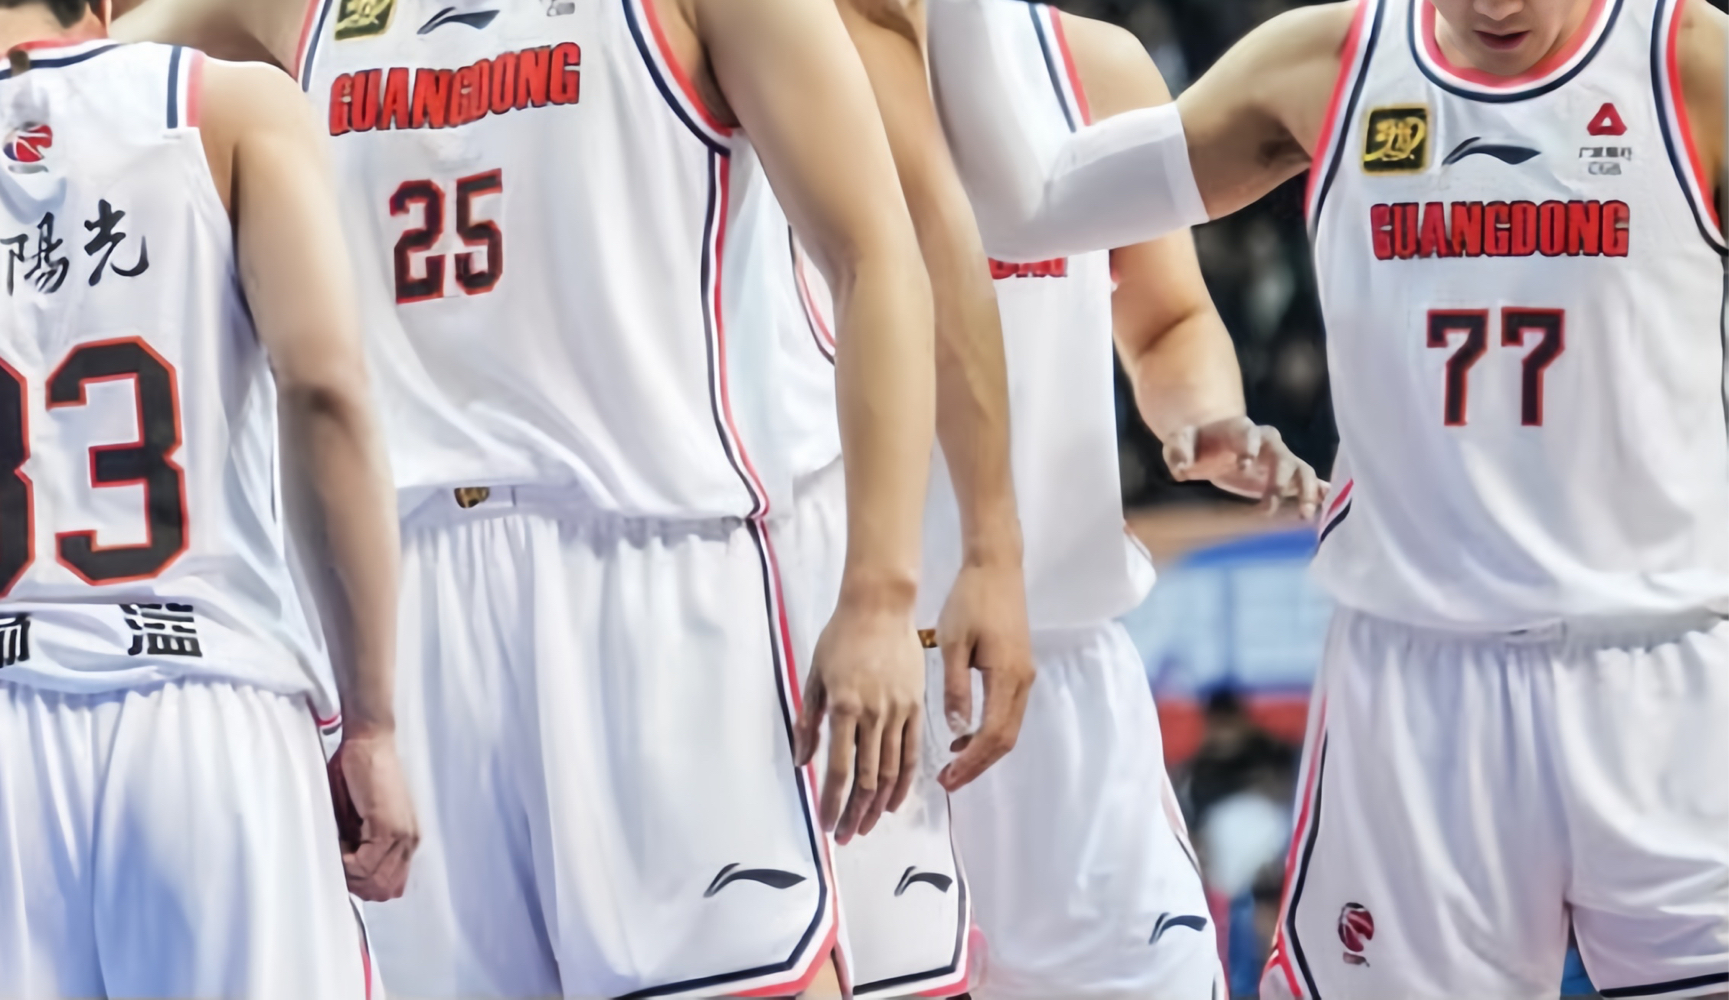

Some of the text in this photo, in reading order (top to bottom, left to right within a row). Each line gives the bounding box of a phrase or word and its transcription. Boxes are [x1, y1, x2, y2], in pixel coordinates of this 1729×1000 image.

[329, 41, 581, 136] GUANGDONG
[389, 168, 503, 305] 25
[1370, 199, 1631, 261] GUANGDONG
[1426, 306, 1566, 427] 77
